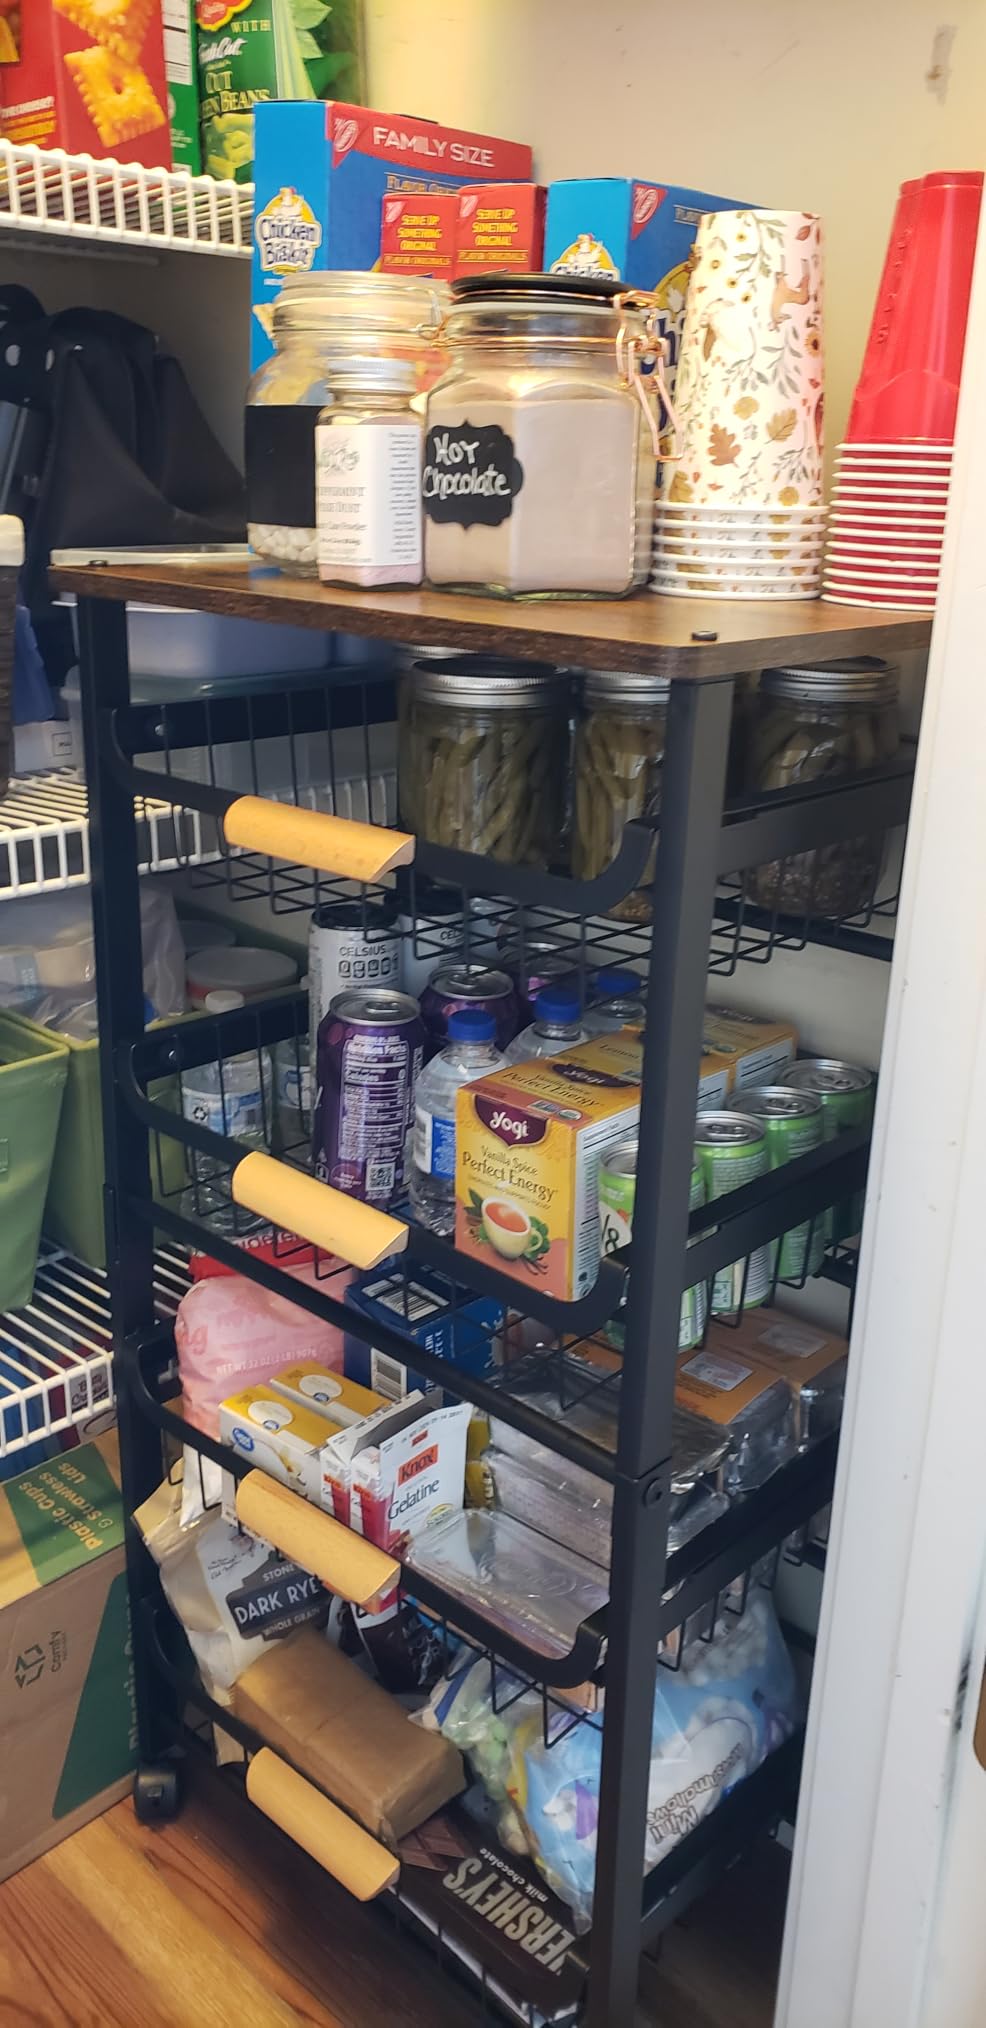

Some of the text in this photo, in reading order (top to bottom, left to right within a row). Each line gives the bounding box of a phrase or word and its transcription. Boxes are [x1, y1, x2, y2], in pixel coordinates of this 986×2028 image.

[231, 19, 271, 33] WITH
[372, 126, 448, 158] FAMILY
[449, 143, 496, 168] SIZE
[401, 214, 440, 226] SERVE UP
[471, 221, 519, 233] SOMETHING
[476, 208, 516, 220] SERVE UP
[260, 218, 317, 242] Chicken
[397, 227, 443, 239] SOMETHING
[400, 239, 437, 251] ORIGINAL
[474, 234, 513, 247] ORIGINAL
[422, 462, 512, 501] Chocolate
[338, 944, 387, 957] CELSIUS
[481, 1144, 538, 1177] Vanilla Spice
[462, 1150, 506, 1182] Perfect
[508, 1168, 557, 1203] Energy
[58, 1461, 87, 1486] Lids
[401, 1448, 434, 1481] Knox
[39, 1471, 103, 1521] Strawless
[387, 1479, 440, 1521] Gelatine
[18, 1480, 104, 1551] Plastic Cups
[234, 1576, 320, 1625] DARK RYE
[263, 1607, 320, 1637] WHOLE GRAIN
[649, 1804, 698, 1845] Mini
[479, 1847, 549, 1904] milk chocolate
